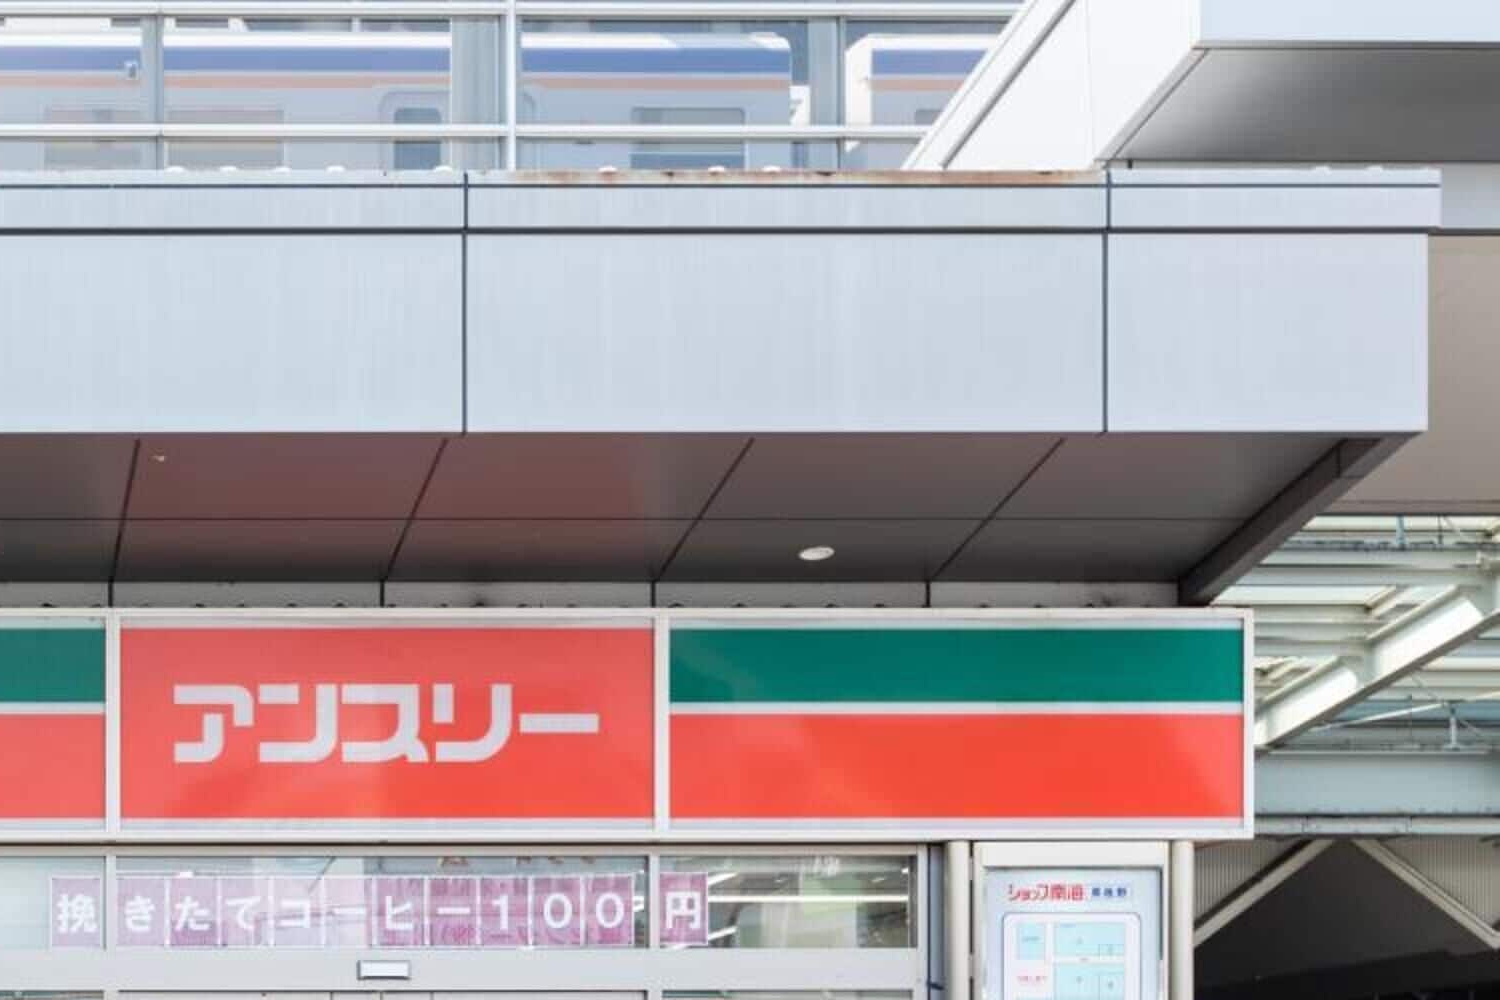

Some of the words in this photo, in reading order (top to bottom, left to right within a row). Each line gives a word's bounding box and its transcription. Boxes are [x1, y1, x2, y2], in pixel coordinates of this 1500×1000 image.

[173, 683, 599, 763] アンスリー
